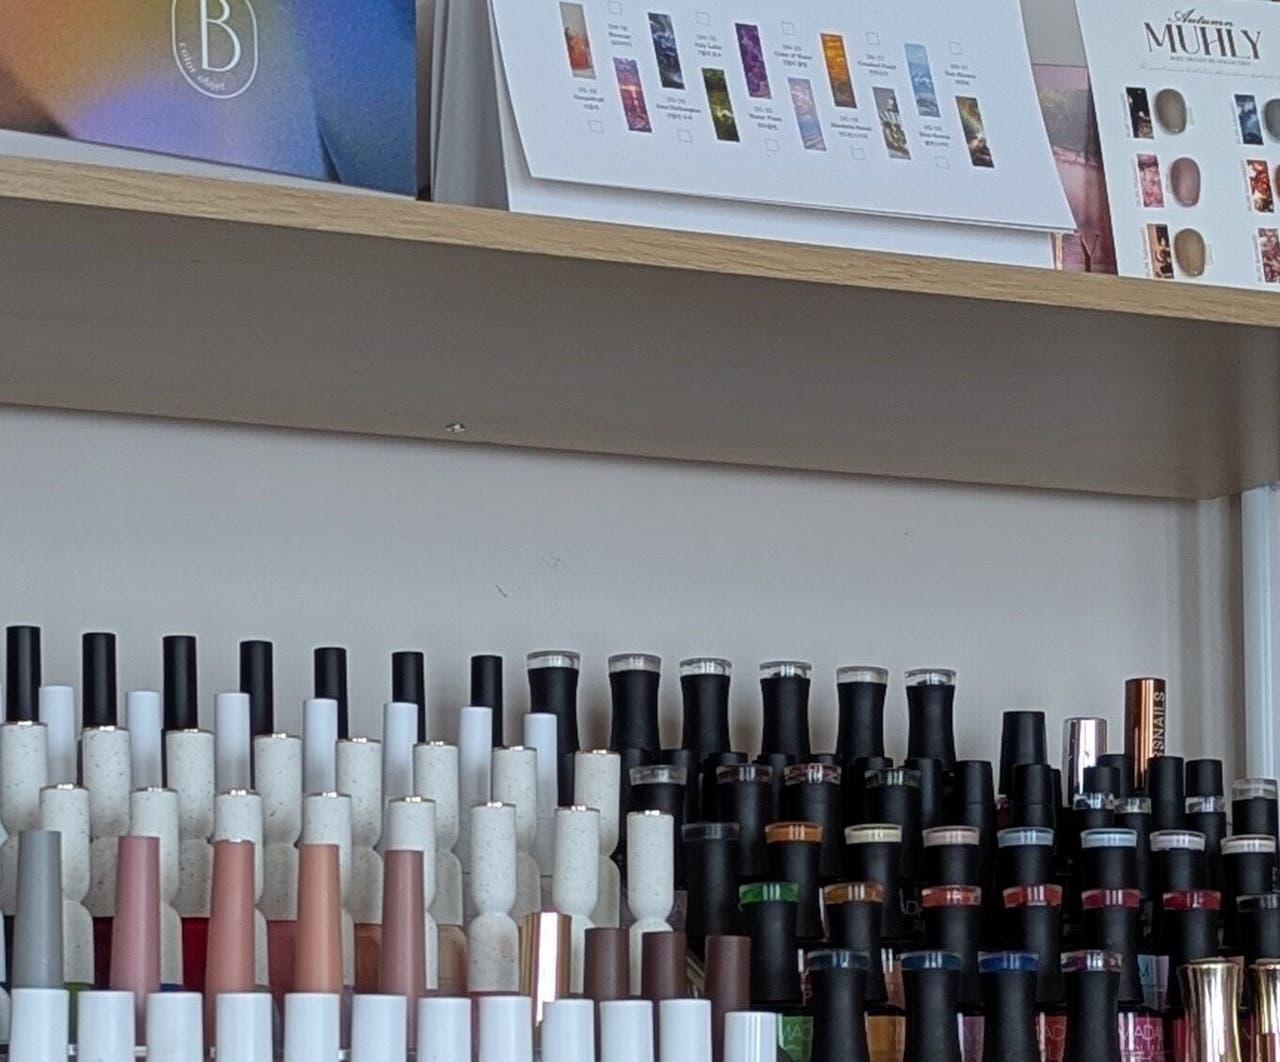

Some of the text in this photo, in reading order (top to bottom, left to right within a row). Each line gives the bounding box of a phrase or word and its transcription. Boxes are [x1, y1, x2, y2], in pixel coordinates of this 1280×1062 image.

[201, 0, 241, 72] B
[1167, 8, 1235, 27] Autumn
[1143, 22, 1261, 60] MUHLY
